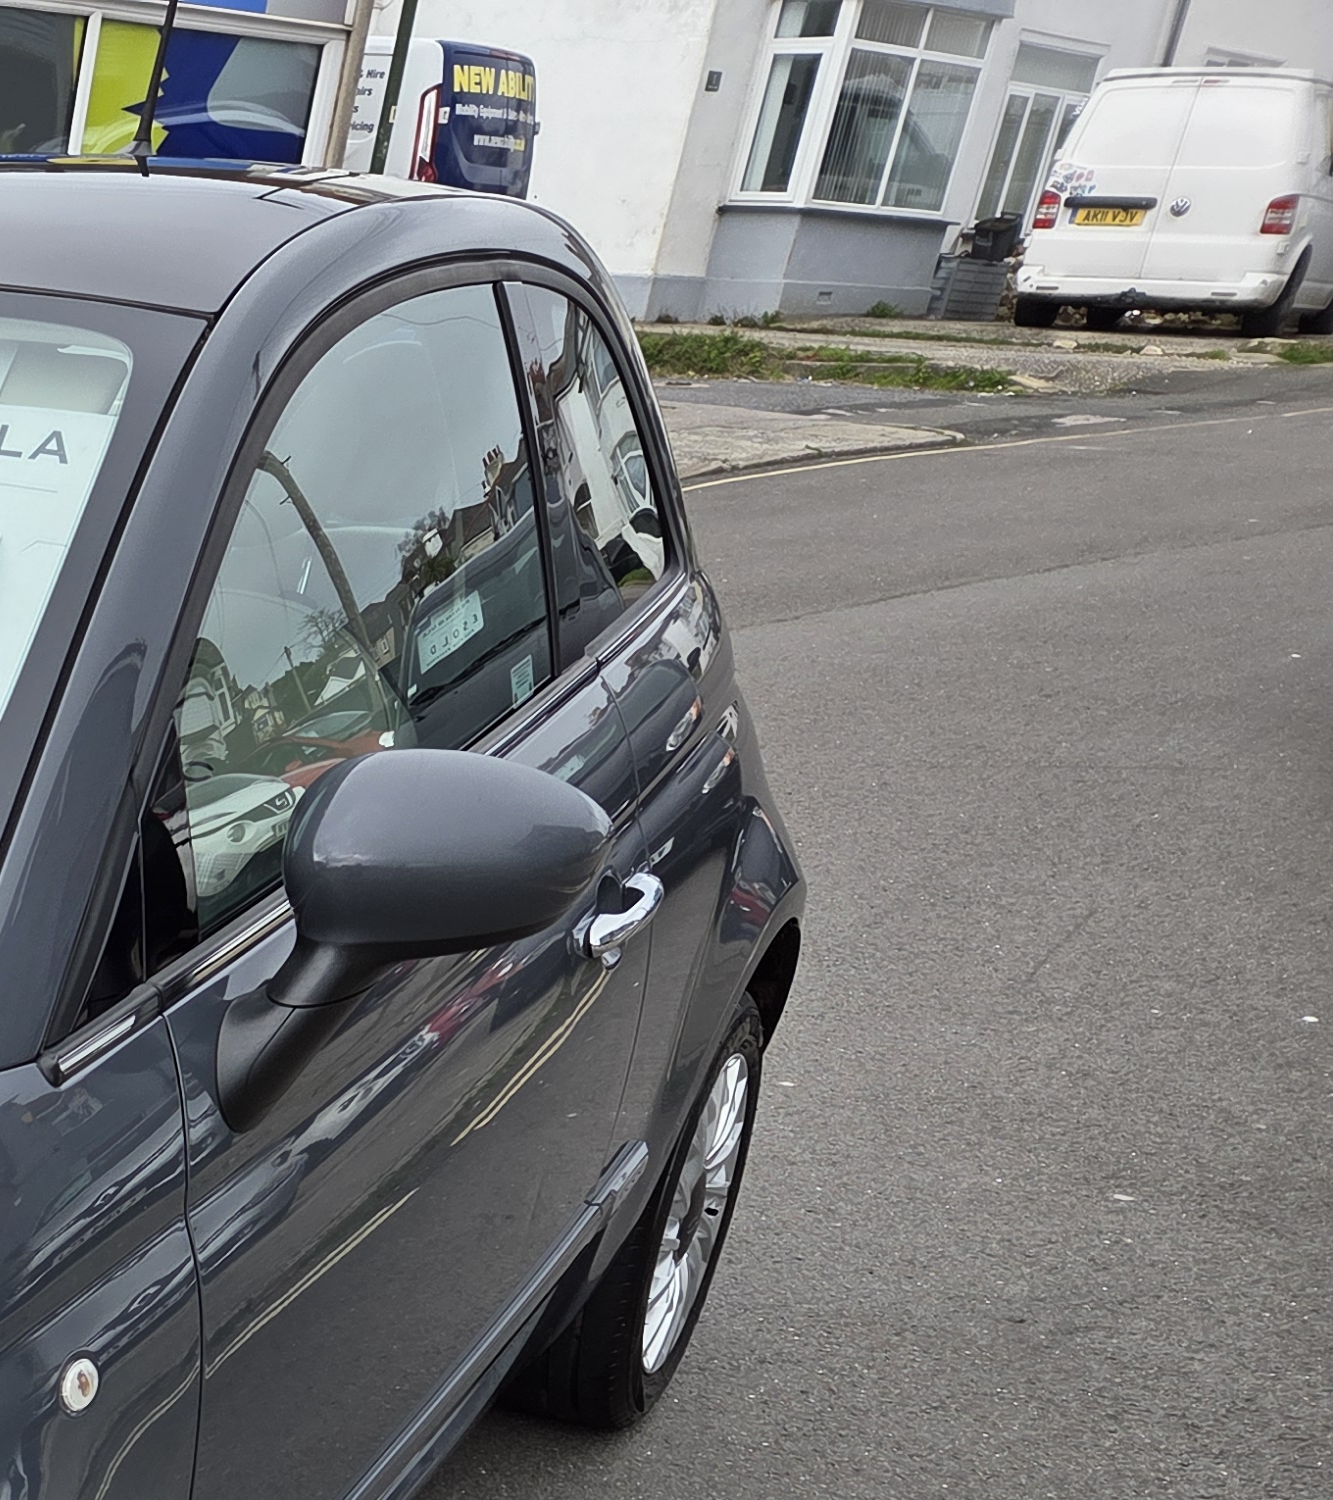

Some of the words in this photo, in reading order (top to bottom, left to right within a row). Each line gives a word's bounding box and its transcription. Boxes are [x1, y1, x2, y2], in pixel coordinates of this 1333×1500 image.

[366, 69, 385, 79] Hire
[453, 64, 495, 94] NEW
[497, 69, 534, 102] ABILIT
